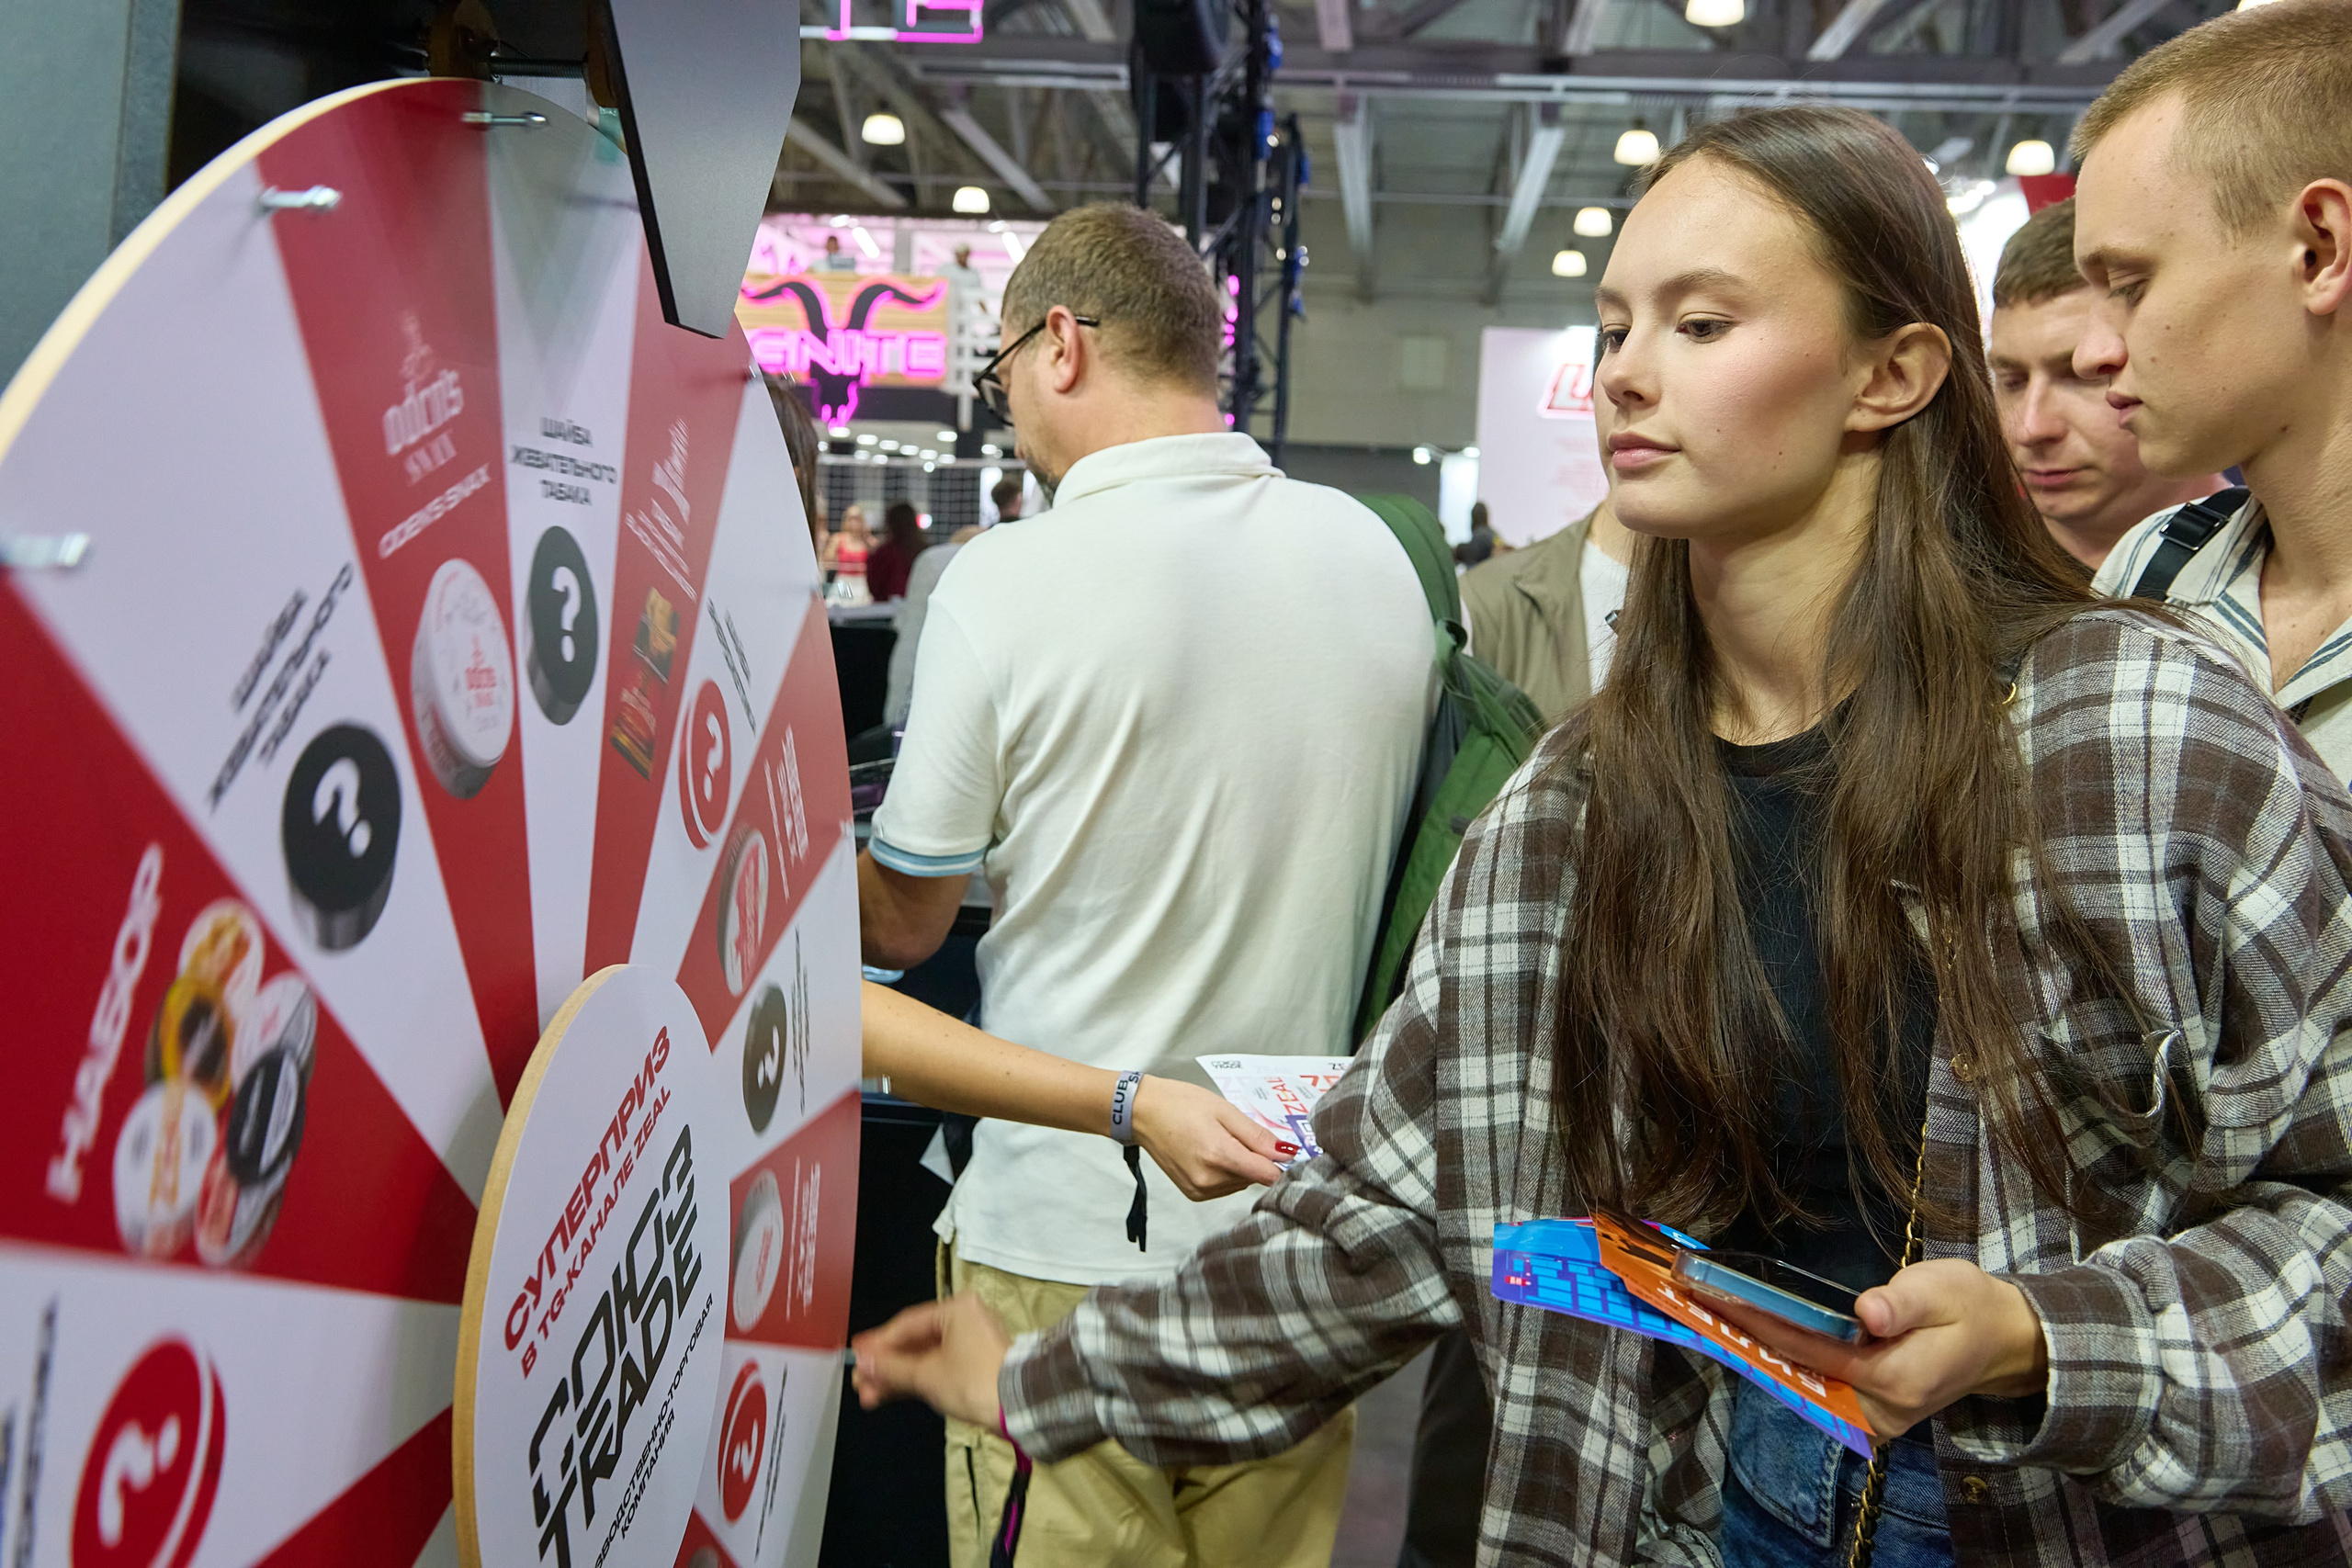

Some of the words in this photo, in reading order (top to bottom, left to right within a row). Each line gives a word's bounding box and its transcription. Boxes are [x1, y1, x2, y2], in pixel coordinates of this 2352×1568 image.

[45, 840, 164, 1205] НАБОР
[1113, 1079, 1128, 1125] CLUB
[1267, 1077, 1308, 1115] ZEAL
[504, 1025, 671, 1351] СУПЕРПРИЗ
[521, 1340, 538, 1380] В
[537, 1149, 635, 1342] TG-КАНАЛЕ
[633, 1086, 671, 1160] ZEAL
[529, 1123, 695, 1529] СОЮЗ
[538, 1201, 702, 1568] TRADE
[621, 1407, 674, 1540] КОМПАНИЯ
